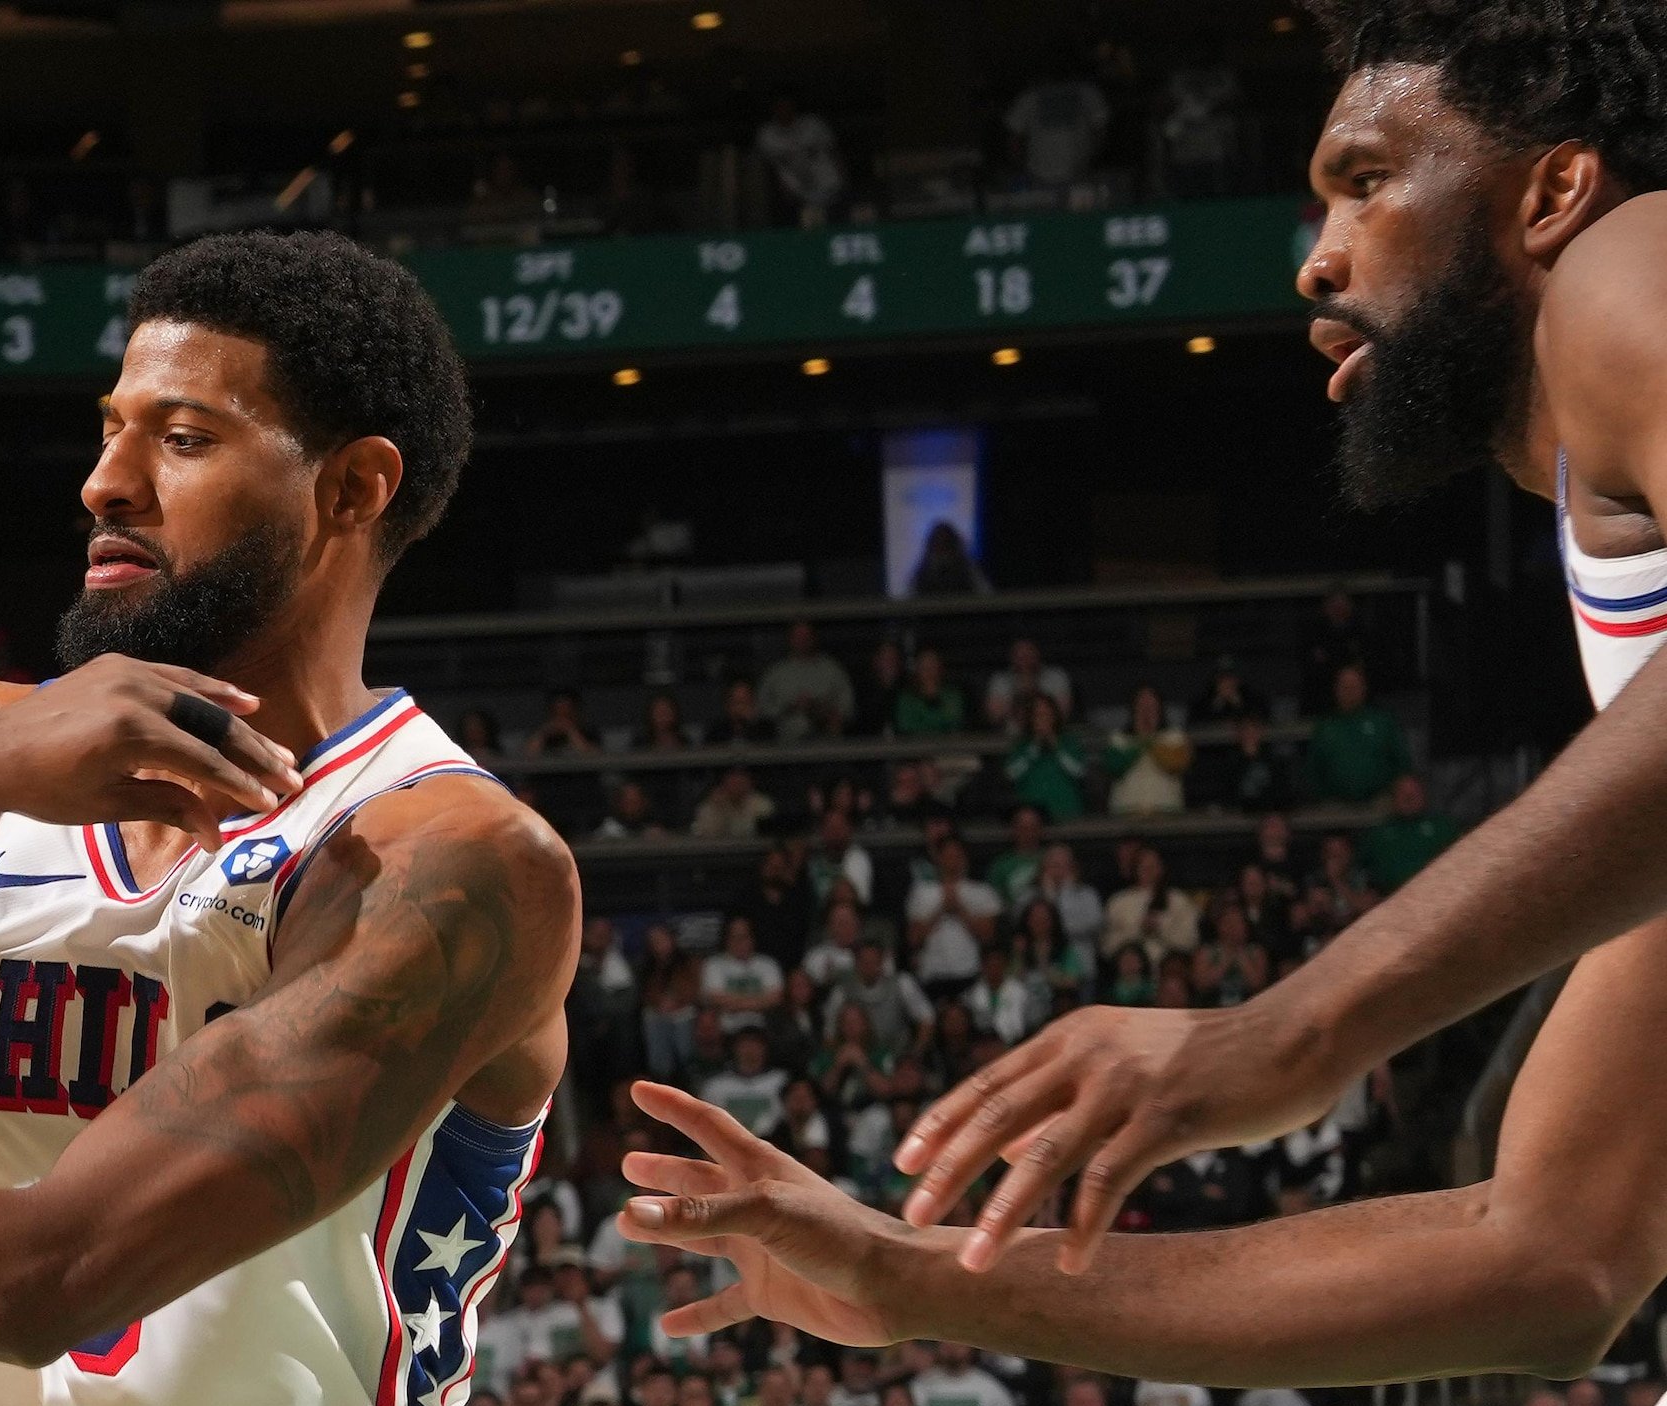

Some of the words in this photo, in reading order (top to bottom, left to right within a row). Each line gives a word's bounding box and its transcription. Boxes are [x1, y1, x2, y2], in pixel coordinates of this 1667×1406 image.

[964, 222, 1028, 256] AST
[707, 283, 741, 330] 4
[841, 275, 877, 322] 4
[974, 265, 1033, 315] 18
[1106, 256, 1172, 309] 37
[2, 315, 35, 364] 3
[481, 290, 624, 343] 12/39
[179, 893, 265, 931] crypto.com
